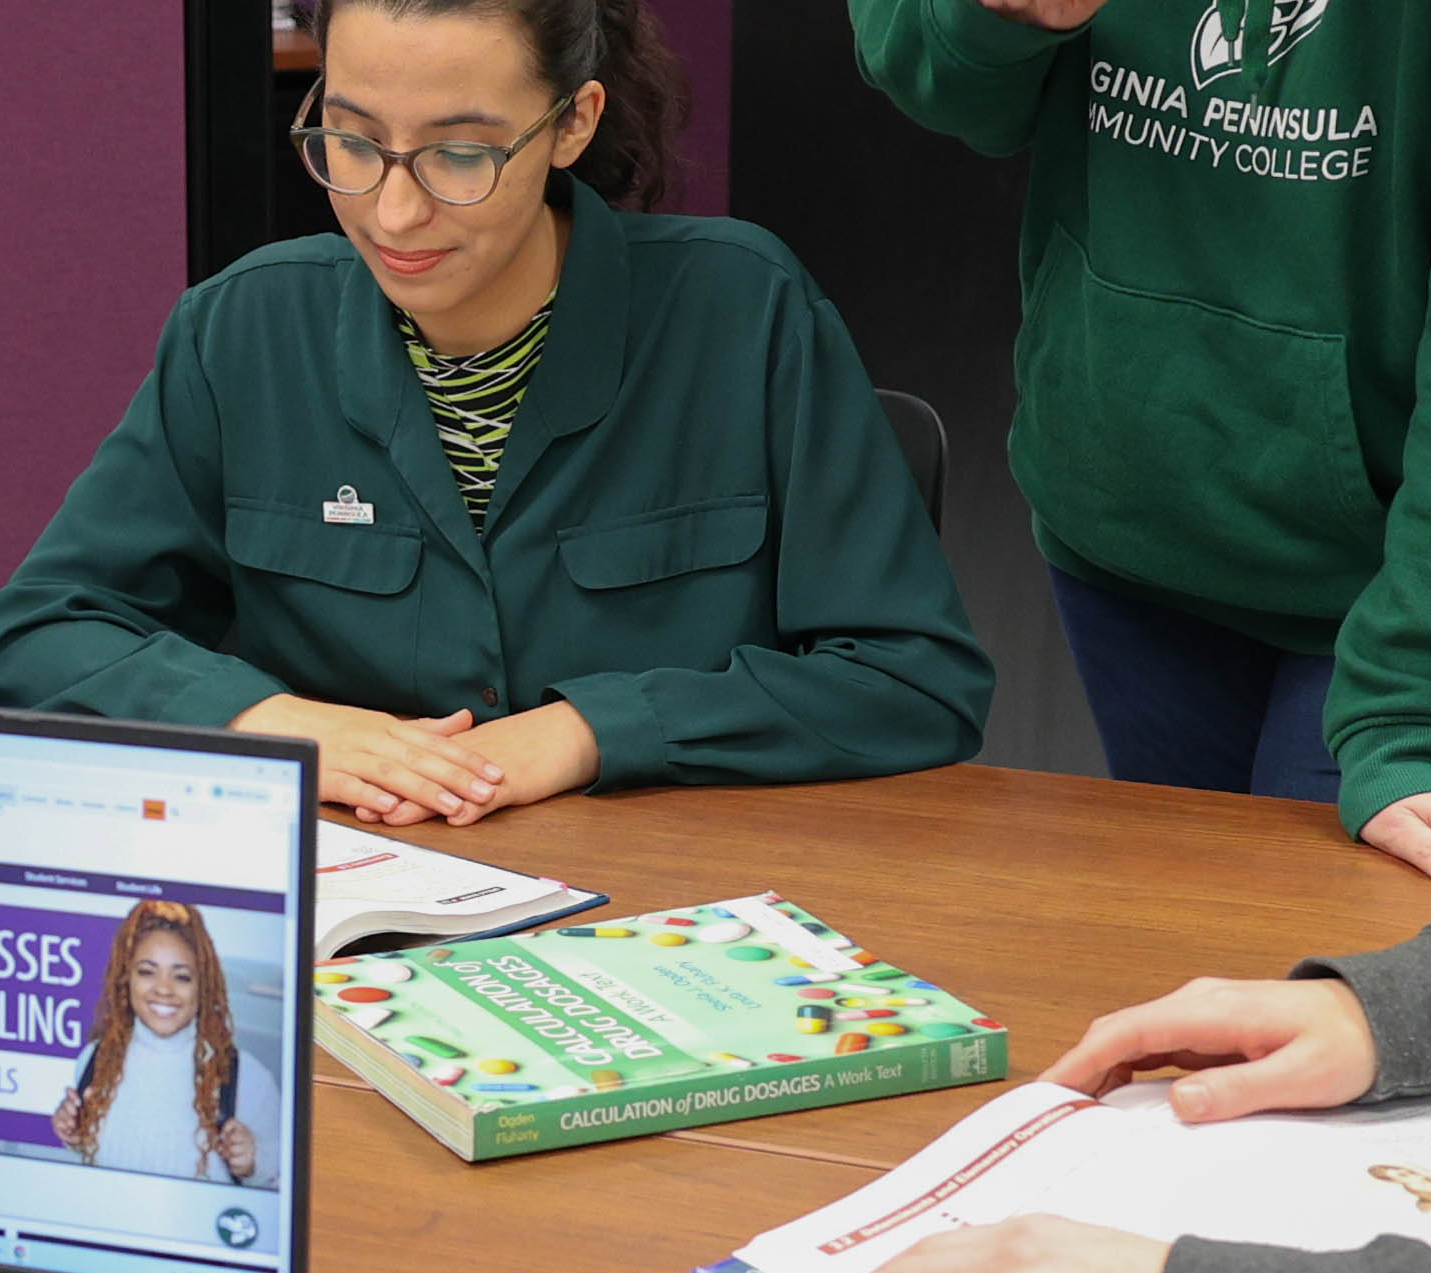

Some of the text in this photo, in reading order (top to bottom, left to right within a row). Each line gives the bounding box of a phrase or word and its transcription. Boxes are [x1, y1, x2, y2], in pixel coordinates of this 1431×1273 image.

[1091, 60, 1378, 143] GINIA PENINSULA
[1236, 144, 1373, 181] COLLEGE
[432, 959, 614, 1066] CALCULATION of
[485, 954, 665, 1060] DRUG DOSAGES
[498, 1113, 536, 1130] Ogden
[560, 1096, 674, 1130] CALCULATION
[675, 1096, 693, 1116] of
[694, 1085, 740, 1110] DRUG
[743, 1073, 821, 1104] DOSAGES
[824, 1077, 835, 1089] A
[837, 1068, 873, 1086] Work
[875, 1063, 902, 1079] Text
[494, 1129, 539, 1146] Fluharty
[935, 1177, 960, 1200] and
[955, 1138, 1018, 1184] Elementary
[1013, 1104, 1076, 1142] Operations
